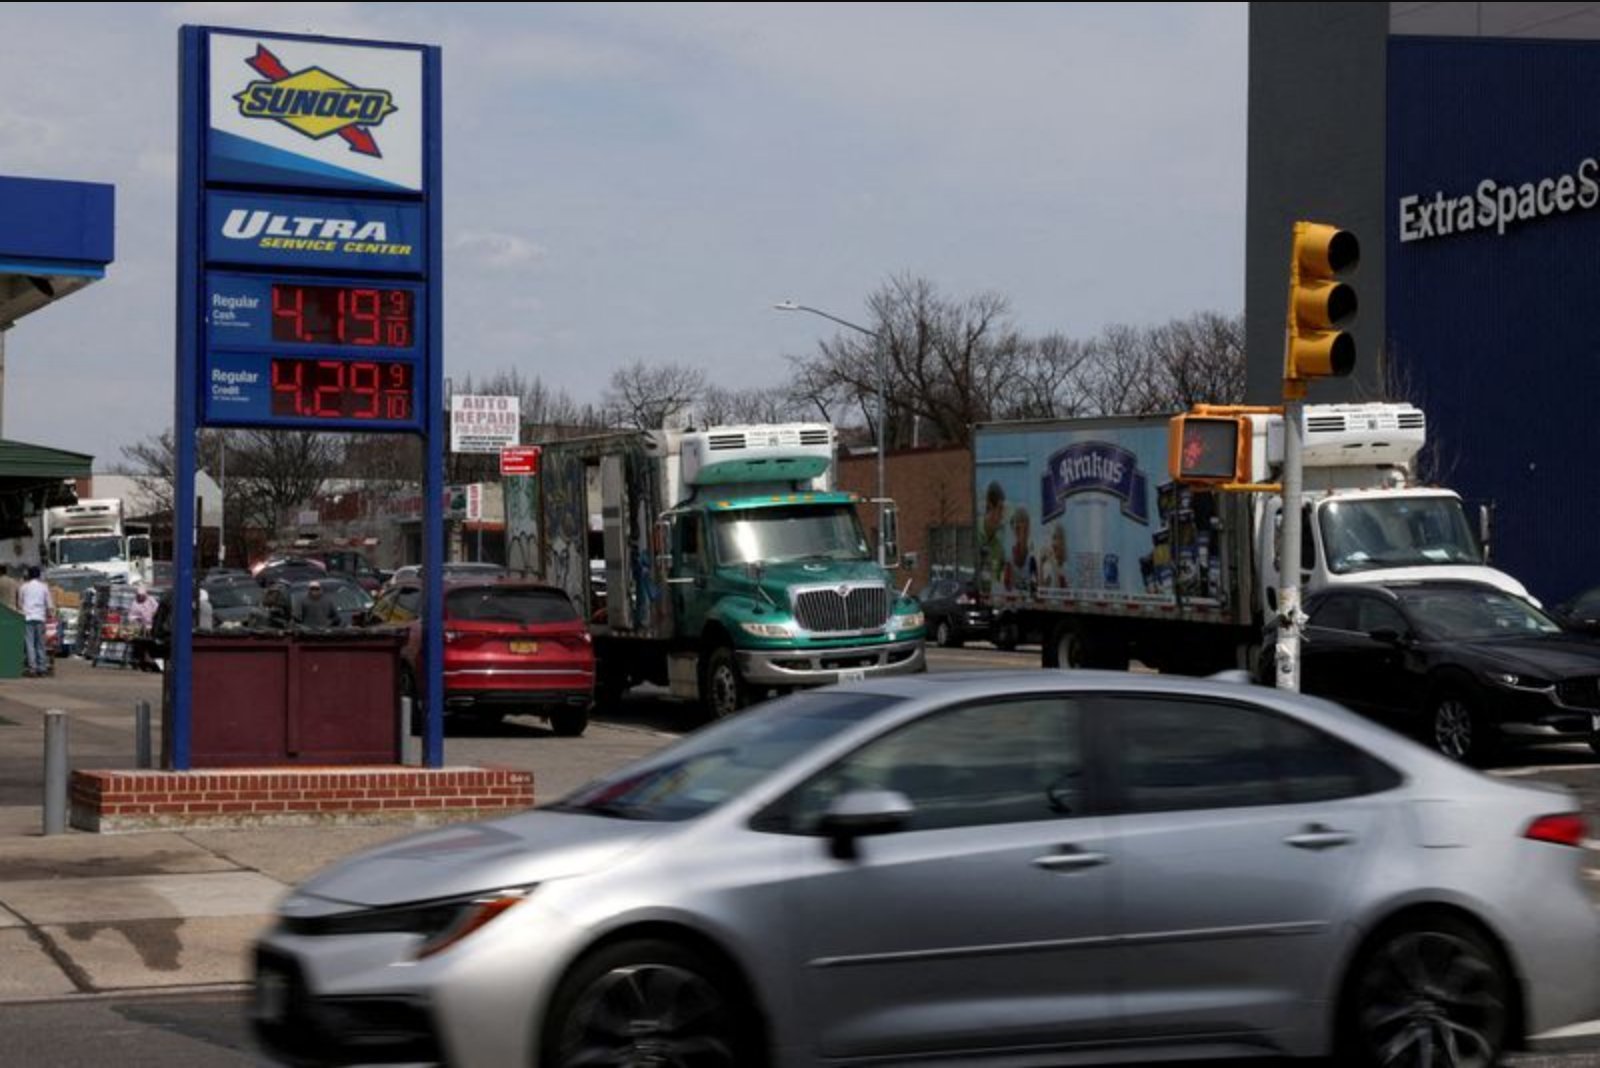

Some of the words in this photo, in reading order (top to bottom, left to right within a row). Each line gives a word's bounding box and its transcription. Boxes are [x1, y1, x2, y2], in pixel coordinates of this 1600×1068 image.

[247, 86, 386, 121] SUNOCO
[221, 209, 387, 241] ULTRA
[259, 236, 336, 252] SERVICE
[343, 241, 412, 255] CENTER
[212, 294, 260, 309] Regular
[212, 310, 236, 320] Cash
[272, 287, 380, 345] 4.19
[387, 322, 407, 346] 10
[212, 369, 260, 385] Regular
[211, 385, 240, 396] Credit
[272, 361, 380, 418] 4.29
[387, 396, 407, 419] 10
[462, 397, 508, 410] AUTO
[454, 411, 516, 424] REPAIR
